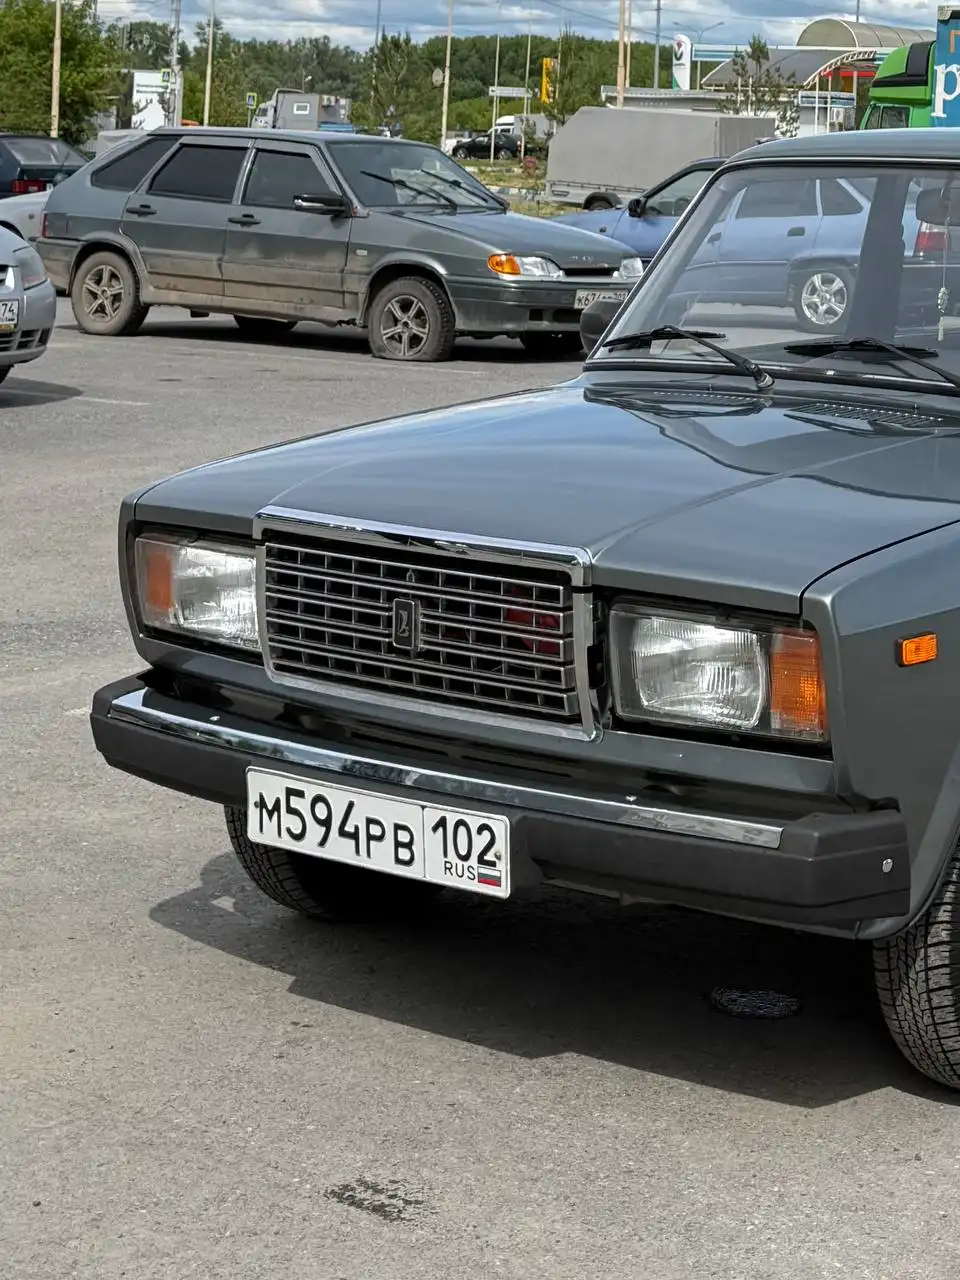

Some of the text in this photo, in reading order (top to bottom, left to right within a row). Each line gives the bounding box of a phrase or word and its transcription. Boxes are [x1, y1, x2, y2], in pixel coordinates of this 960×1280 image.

[258, 786, 497, 868] М594РВ 102
[443, 860, 476, 882] RUS
